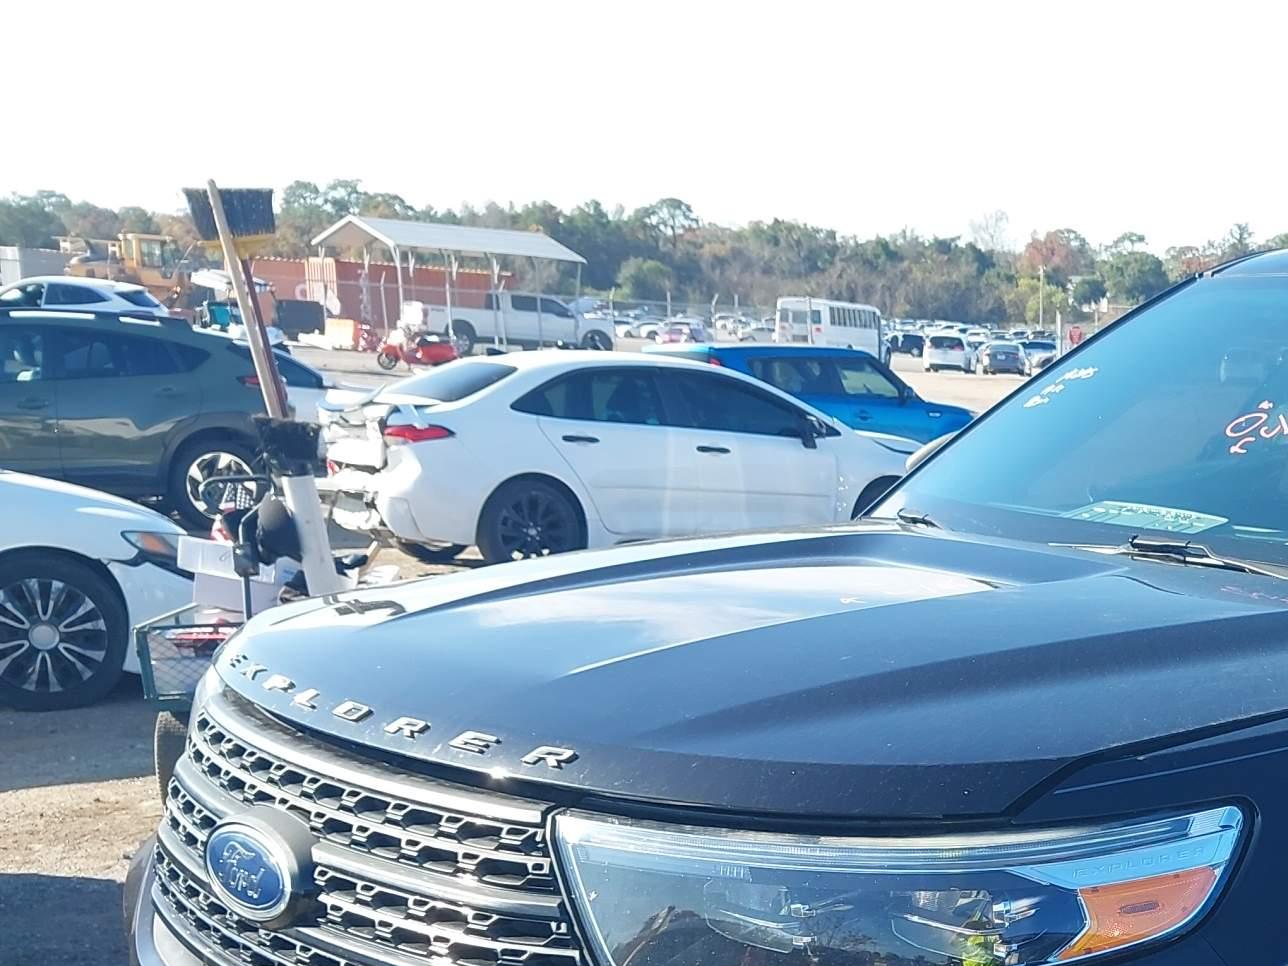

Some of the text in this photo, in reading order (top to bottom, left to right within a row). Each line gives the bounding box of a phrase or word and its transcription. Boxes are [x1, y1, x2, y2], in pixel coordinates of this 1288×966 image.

[228, 653, 581, 770] EXPLORER
[218, 840, 267, 900] Ford
[1072, 847, 1206, 880] EXPLORER
